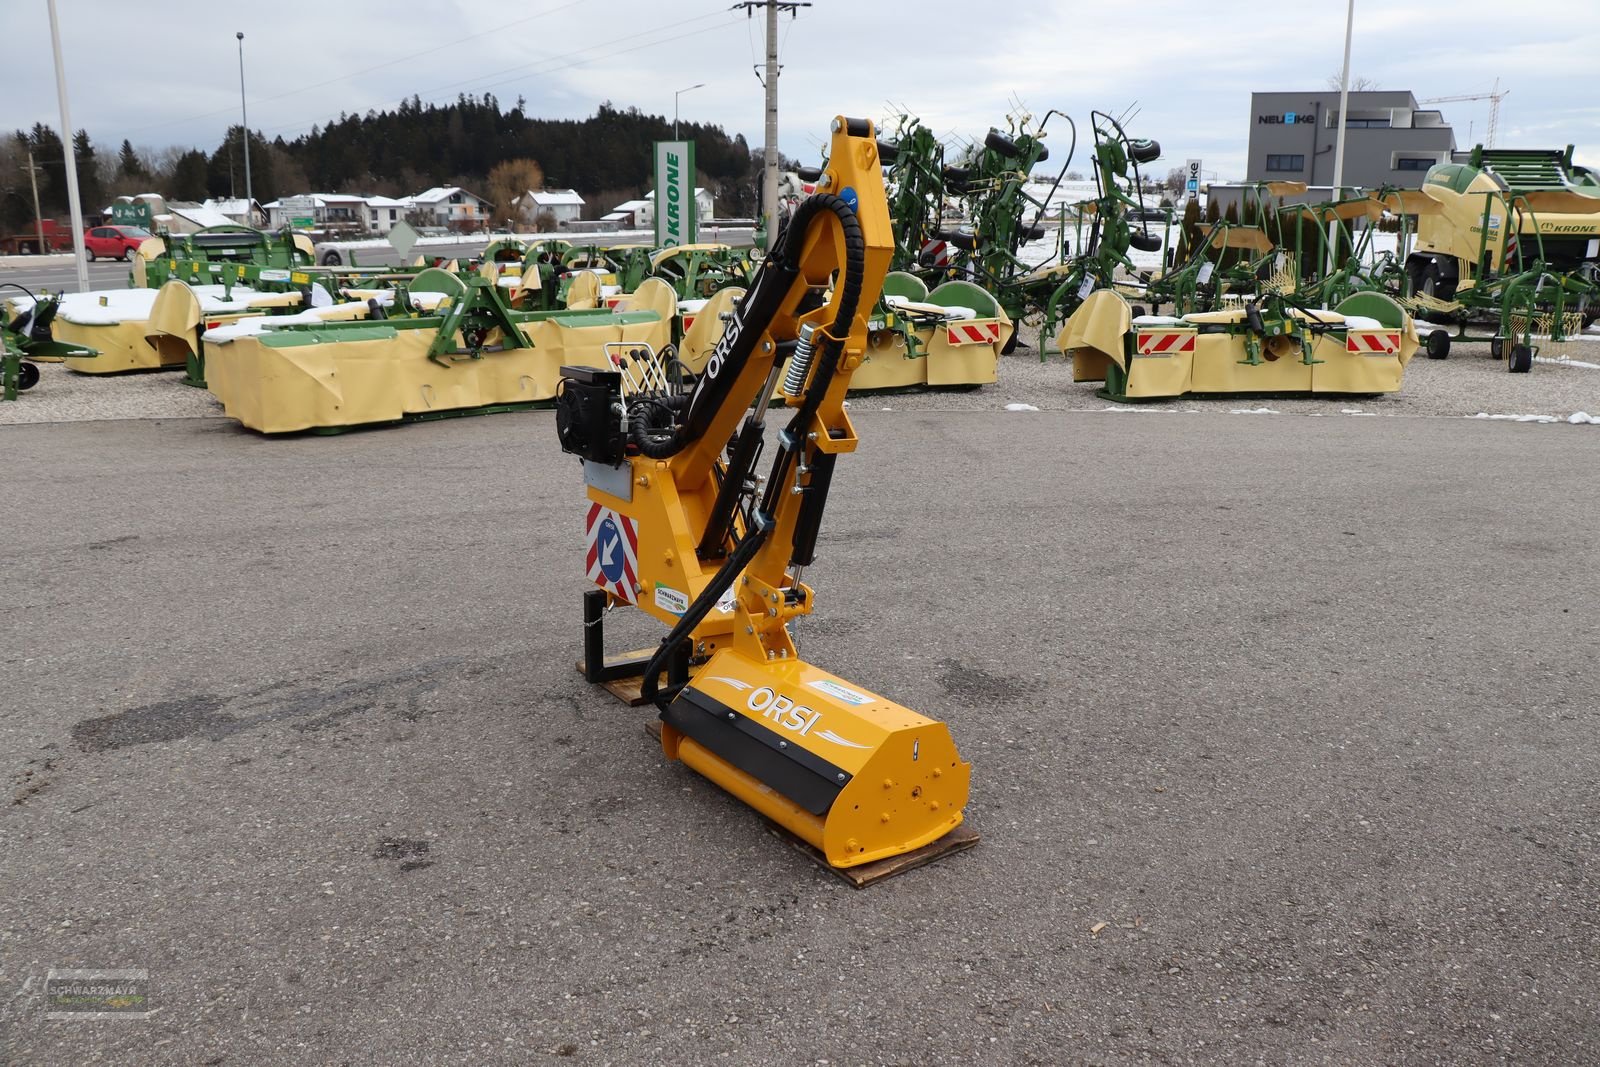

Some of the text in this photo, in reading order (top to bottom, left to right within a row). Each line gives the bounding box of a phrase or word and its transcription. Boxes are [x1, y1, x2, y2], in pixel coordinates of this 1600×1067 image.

[667, 152, 679, 236] KRONE
[1554, 225, 1597, 233] KRONE
[707, 312, 744, 379] ORSI
[747, 686, 823, 736] ORSI
